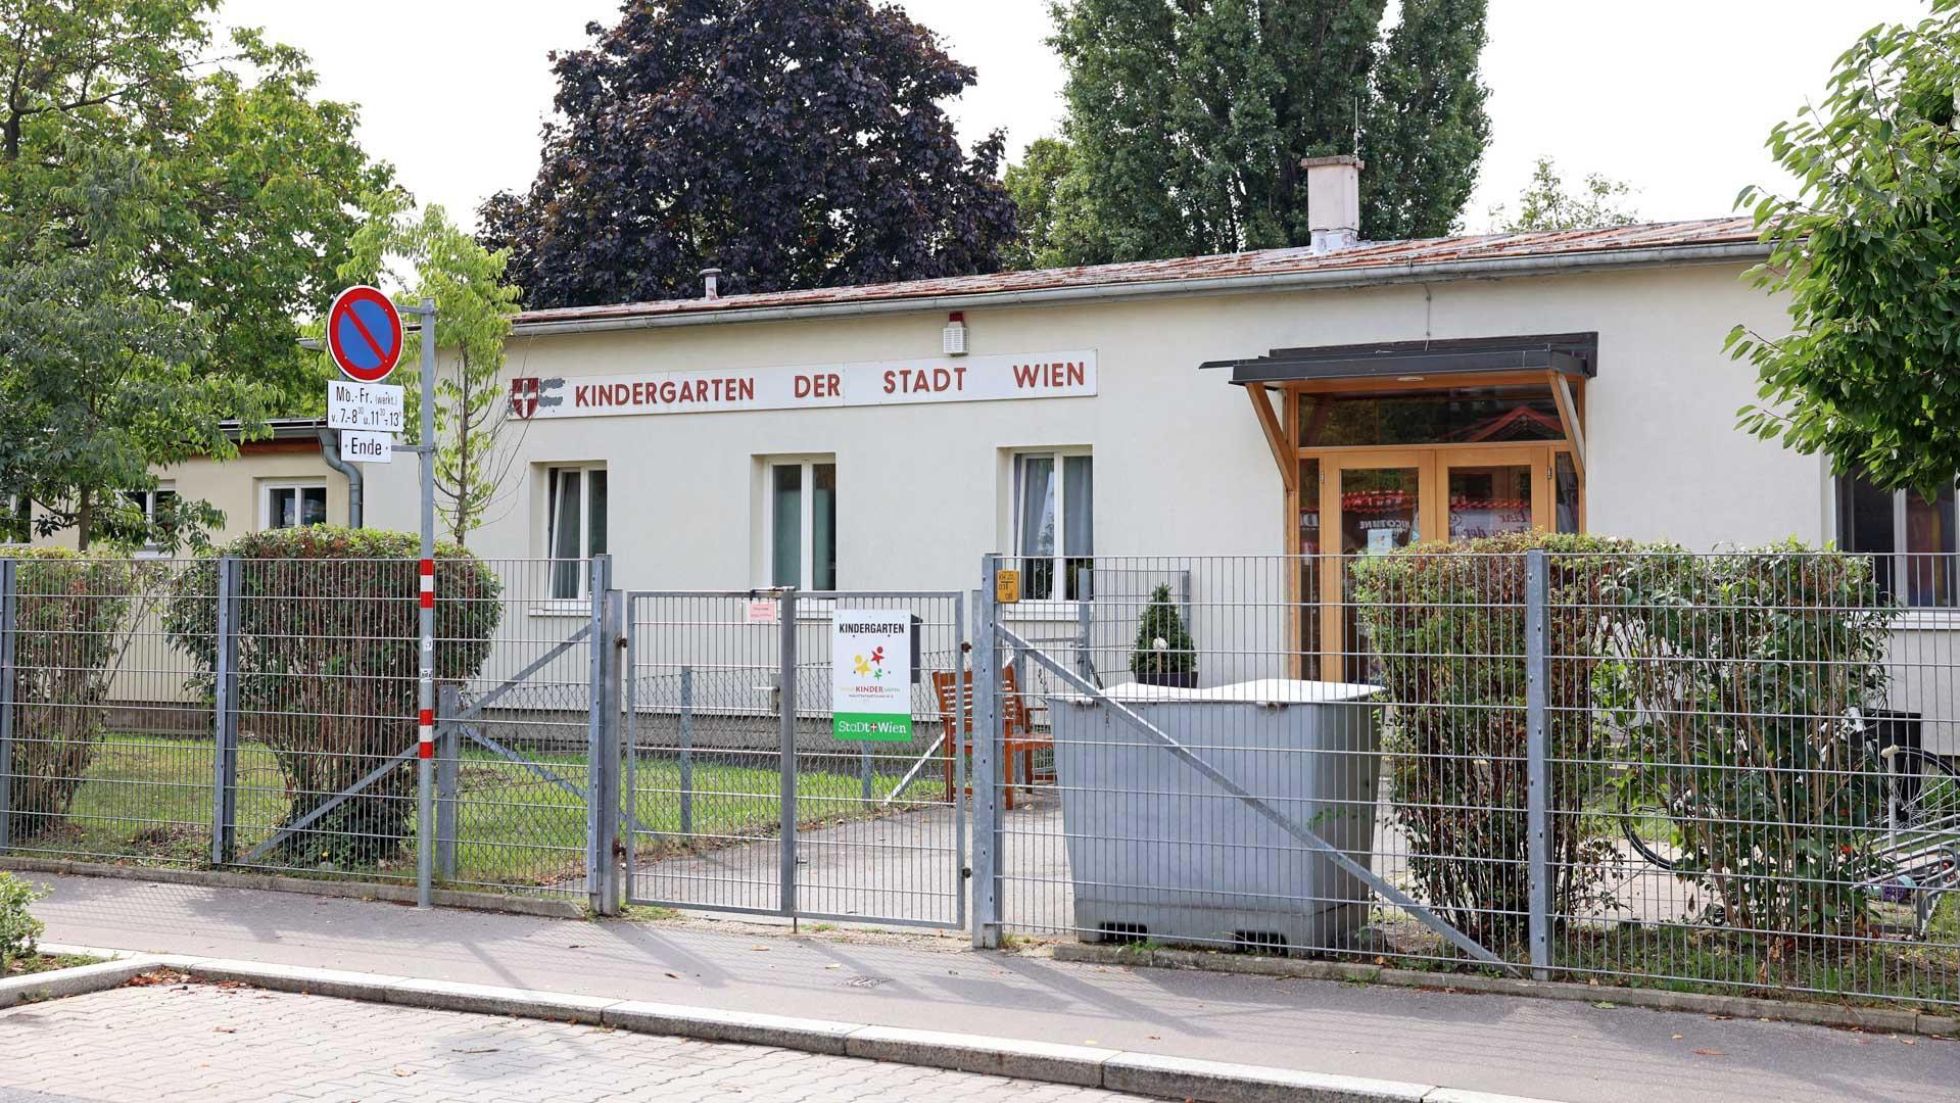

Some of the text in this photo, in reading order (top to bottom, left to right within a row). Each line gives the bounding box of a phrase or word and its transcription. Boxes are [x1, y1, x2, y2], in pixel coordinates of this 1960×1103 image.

[575, 362, 1085, 408] KINDERGARTEN DER STADT WIEN
[351, 437, 382, 456] Ende
[839, 623, 905, 634] KINDERGARTEN
